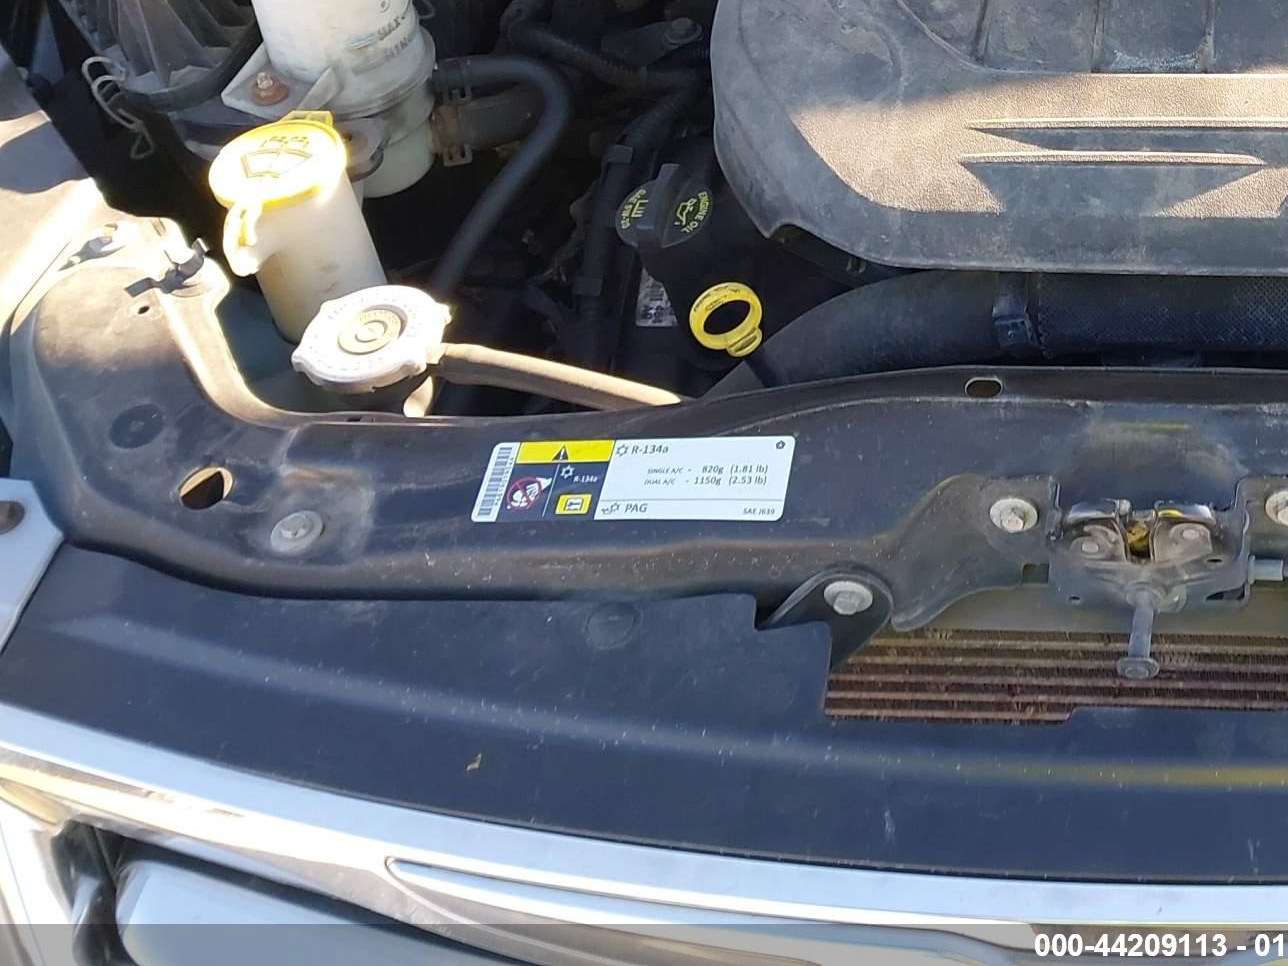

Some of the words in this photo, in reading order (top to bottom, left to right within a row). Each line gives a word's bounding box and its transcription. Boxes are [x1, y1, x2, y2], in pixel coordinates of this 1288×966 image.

[695, 191, 709, 221] ENGINE
[681, 221, 699, 233] OIL
[631, 444, 669, 455] R-134a
[702, 465, 724, 475] 820g
[730, 464, 753, 475] (1.81
[756, 464, 768, 475] lb)
[694, 476, 722, 486] 1150g
[754, 475, 767, 486] lb)
[625, 503, 648, 513] PAG
